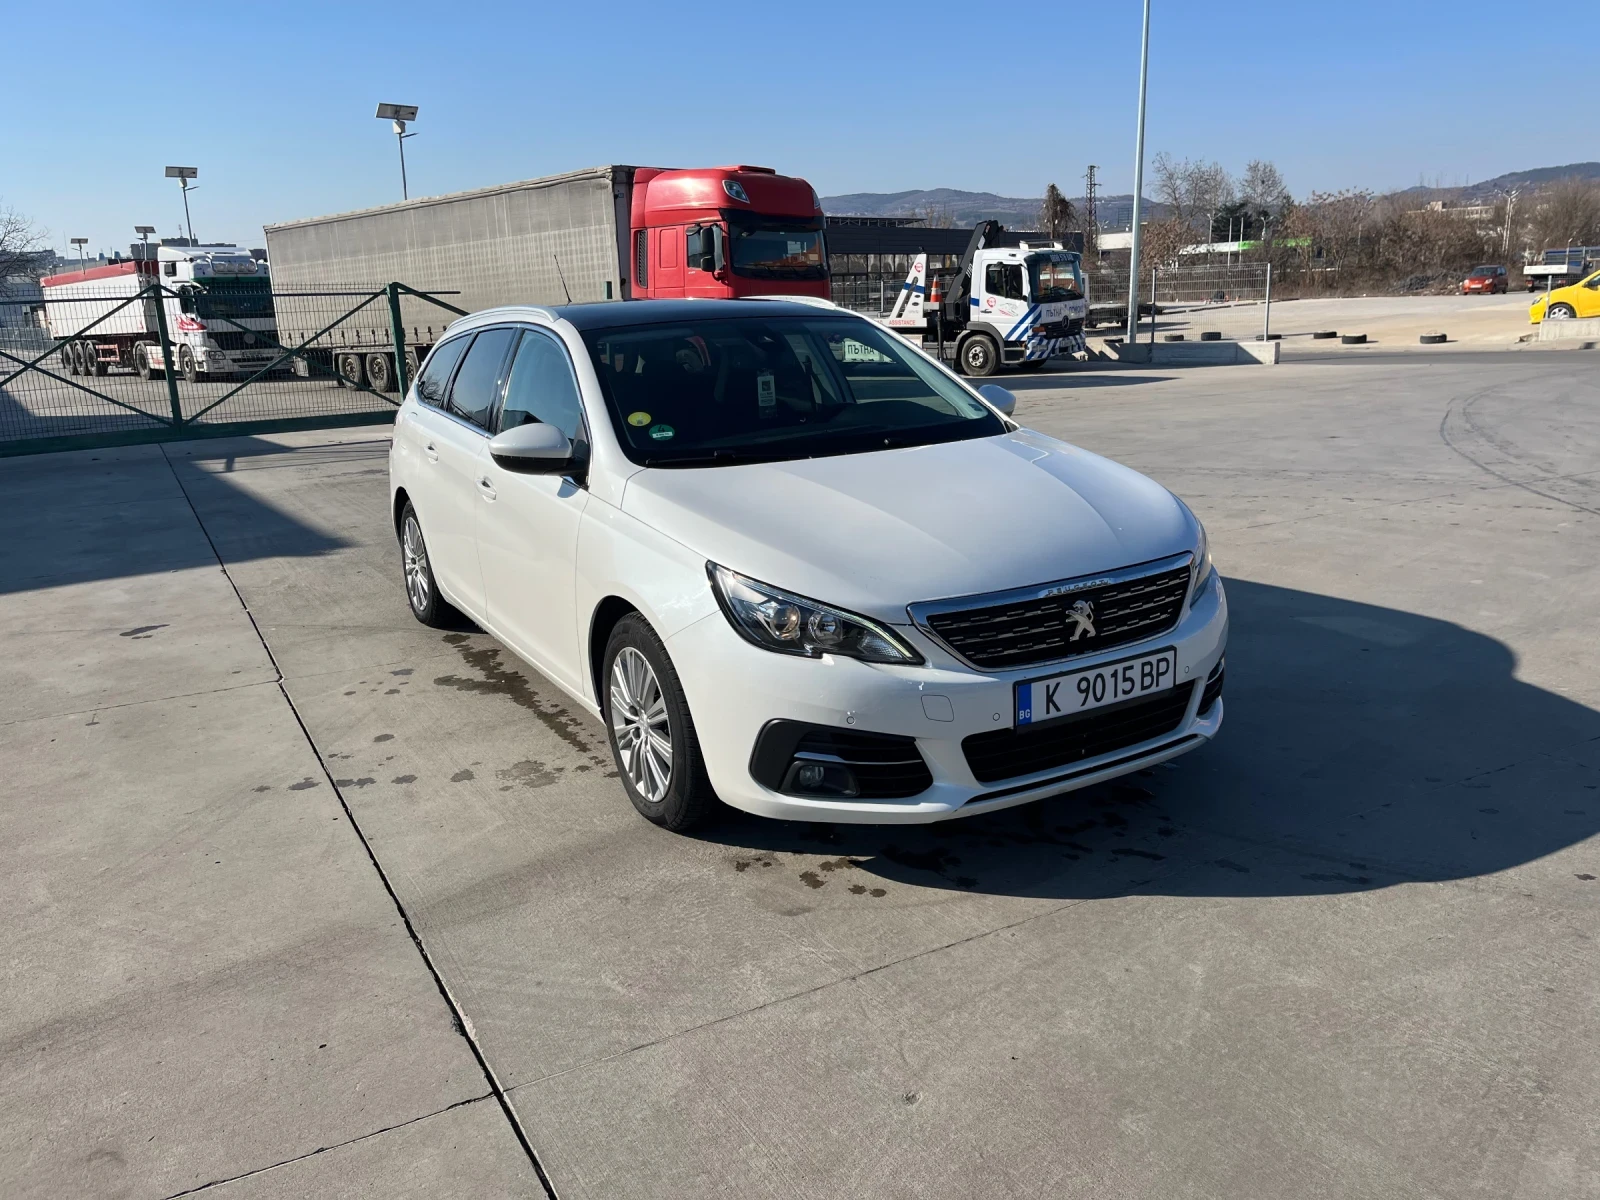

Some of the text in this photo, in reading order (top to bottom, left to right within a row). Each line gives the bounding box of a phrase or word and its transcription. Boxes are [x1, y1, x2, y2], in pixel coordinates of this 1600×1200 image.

[1047, 579, 1109, 597] PEUGEOT
[1045, 682, 1062, 715] K
[1019, 709, 1031, 720] BG
